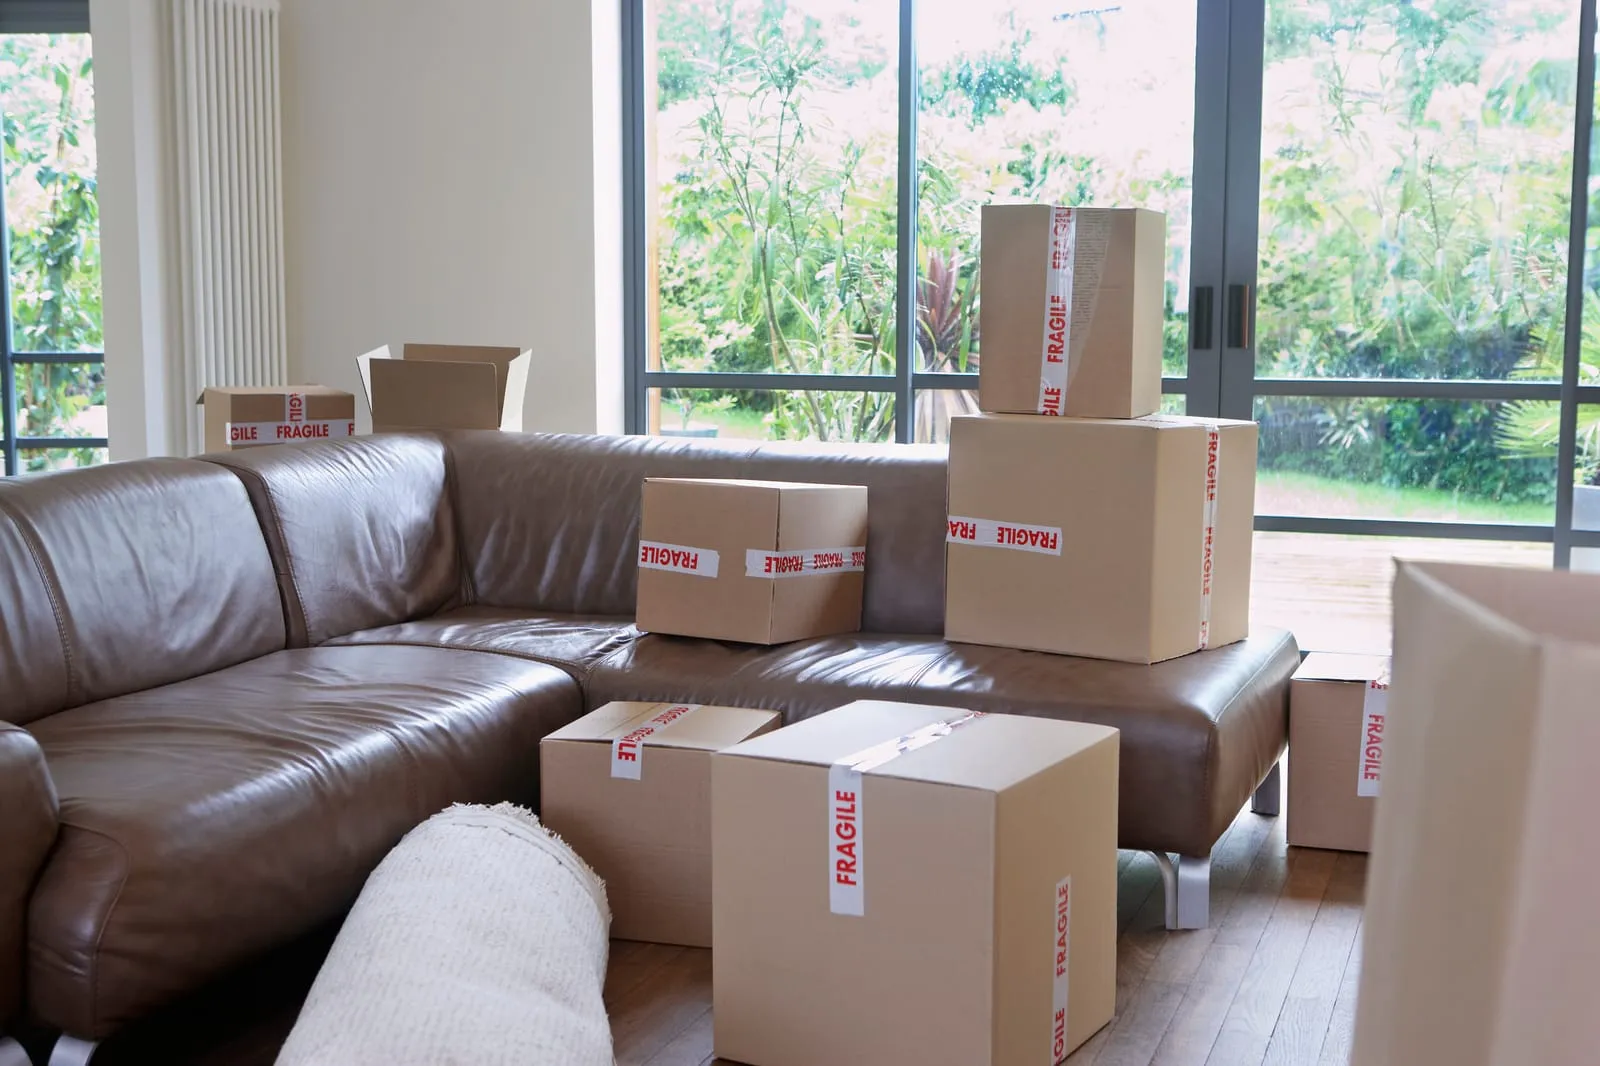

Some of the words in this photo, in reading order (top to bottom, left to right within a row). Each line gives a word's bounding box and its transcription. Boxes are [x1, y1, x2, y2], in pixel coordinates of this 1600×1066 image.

[1047, 295, 1067, 363] FRAGILE
[289, 393, 303, 422] GIL
[276, 424, 329, 439] FRAGILE
[1206, 431, 1218, 502] FRAGILE
[997, 526, 1058, 550] FRAGILE
[641, 546, 699, 570] FRAGILE
[764, 555, 804, 573] FRAGILE
[813, 552, 843, 569] FRAGILE
[1364, 713, 1385, 781] FRAGILE
[835, 790, 857, 886] FRAGILE
[1056, 883, 1068, 979] FRAGILE
